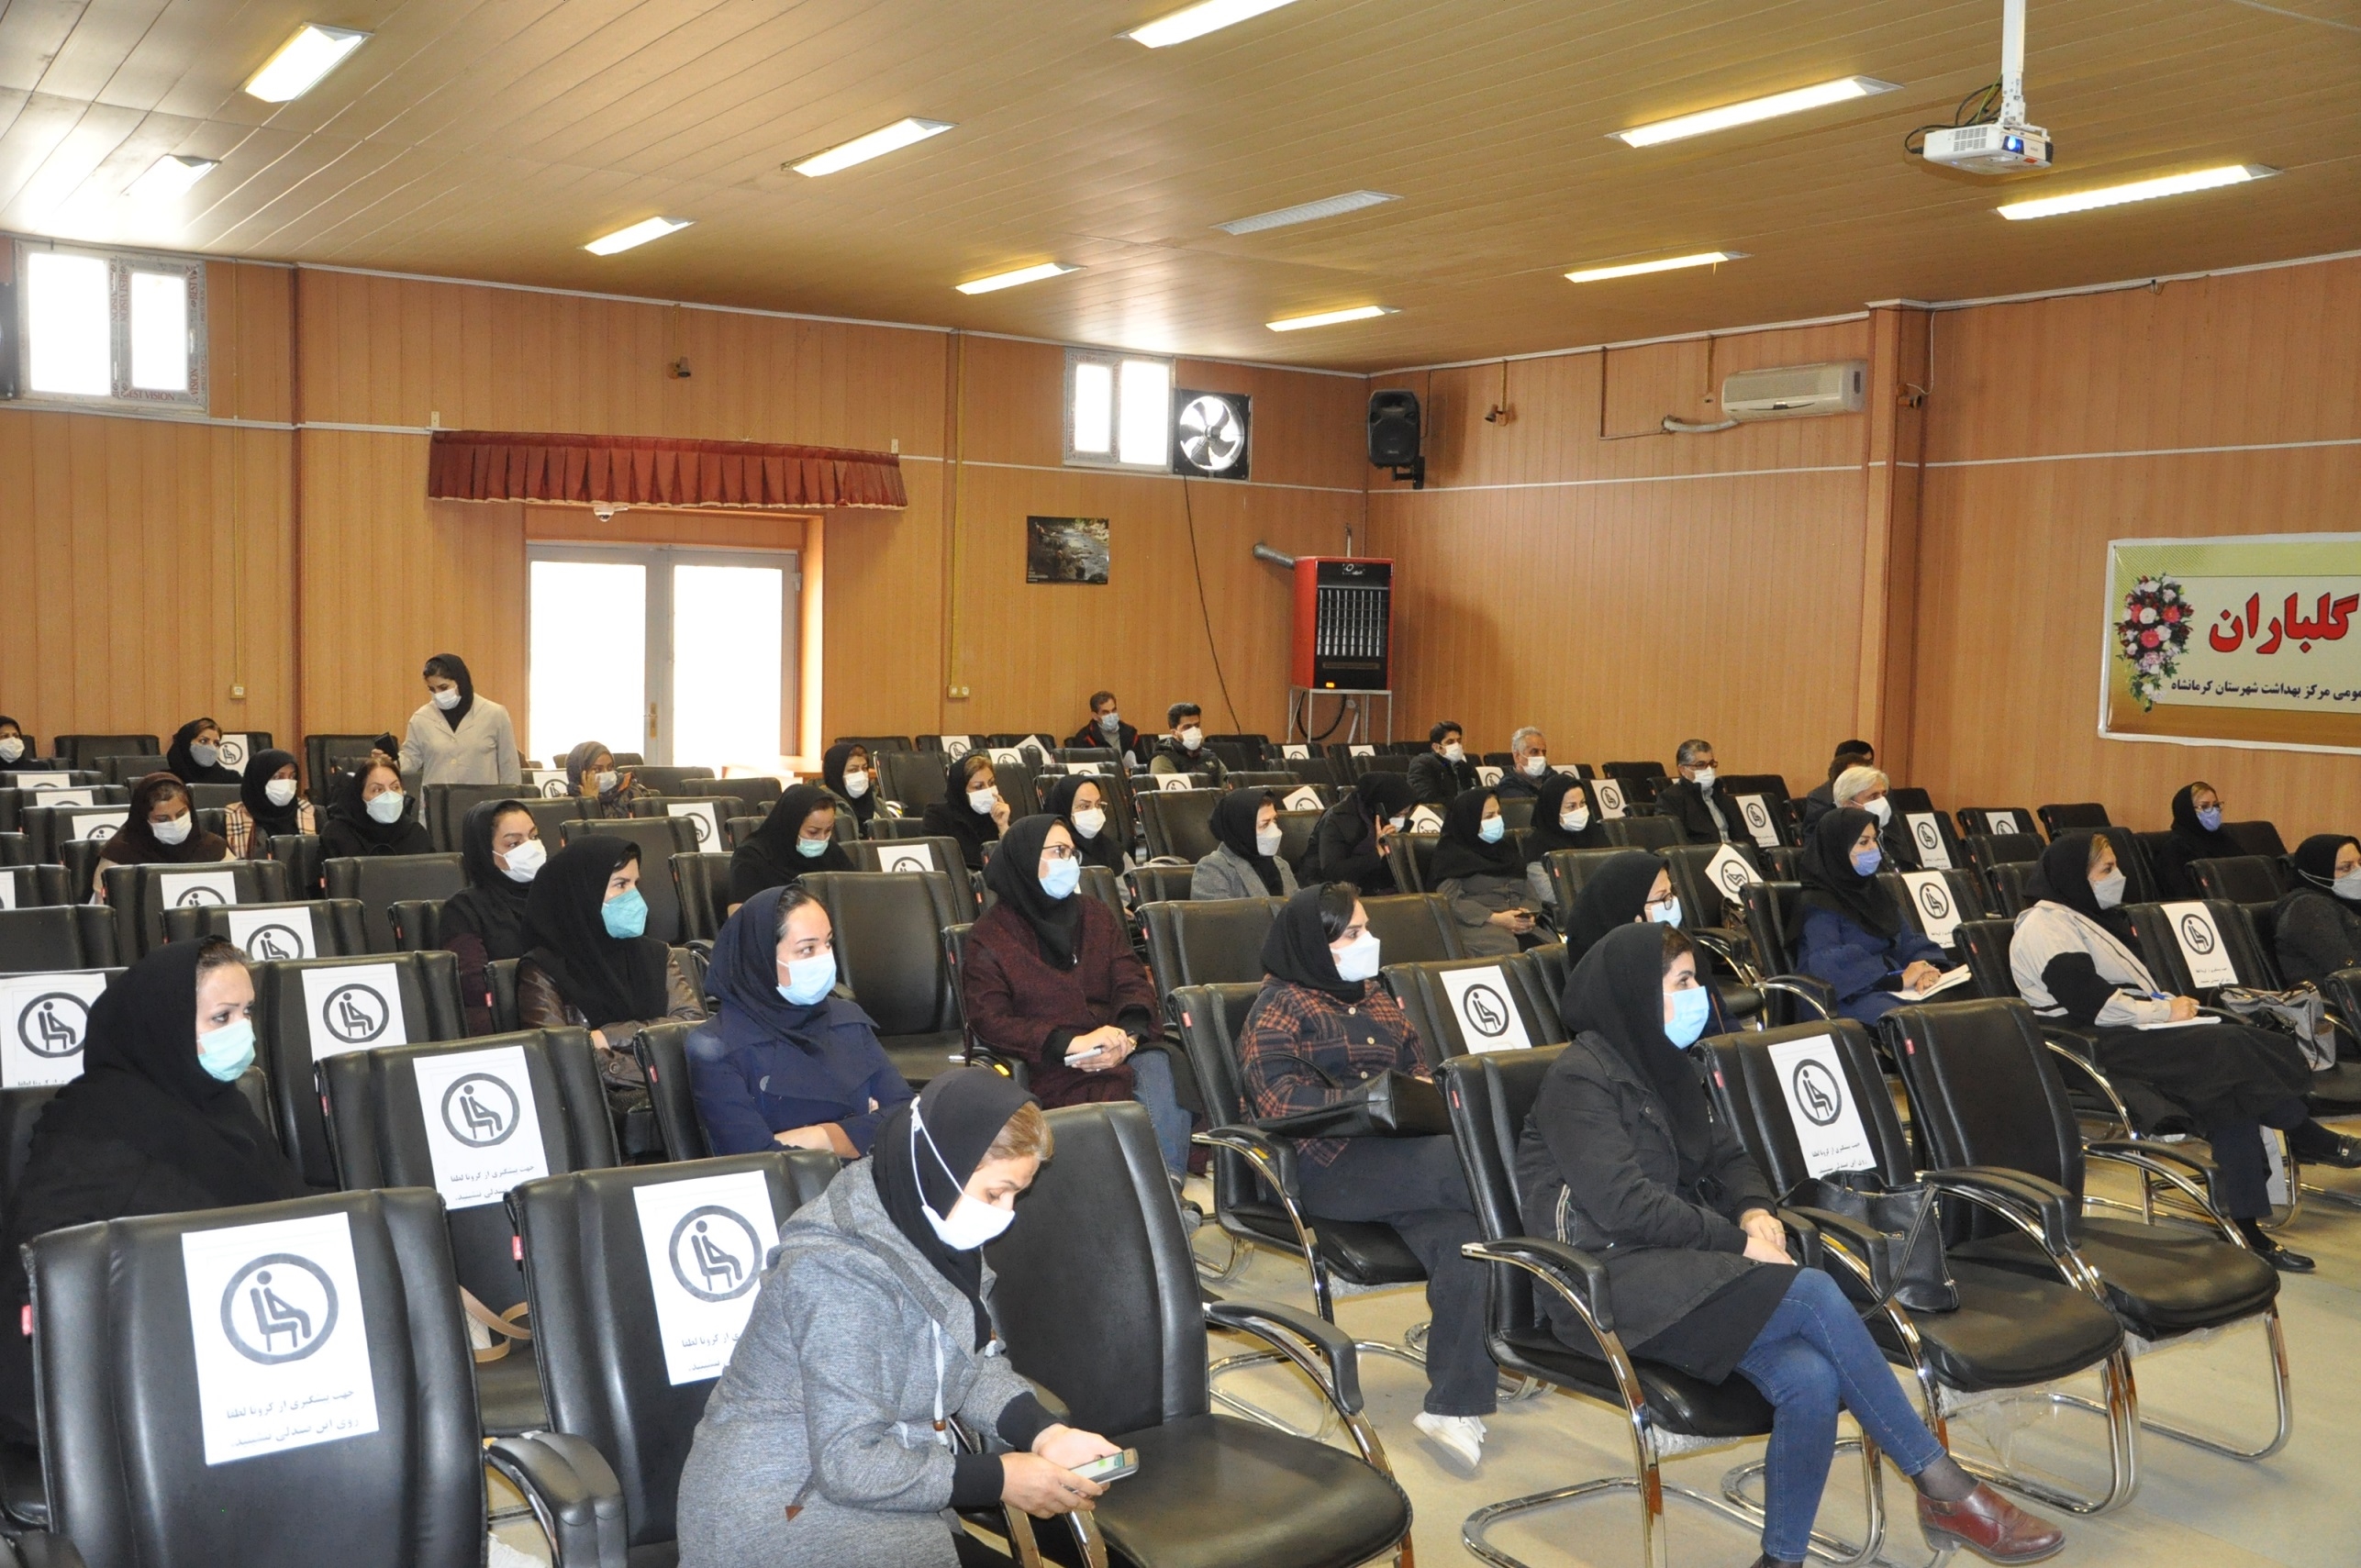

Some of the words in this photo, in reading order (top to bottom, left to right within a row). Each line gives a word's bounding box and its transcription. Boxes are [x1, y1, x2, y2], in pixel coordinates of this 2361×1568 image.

[119, 274, 128, 292] BEST
[119, 293, 128, 322] VISION
[190, 369, 199, 395] VISION
[145, 390, 175, 400] VISION
[2209, 592, 2360, 654] گلباران
[2171, 680, 2213, 695] کرمانشاه
[2215, 681, 2258, 696] شهرستان
[2261, 683, 2301, 698] بهداشت
[2303, 684, 2331, 701] مرکز
